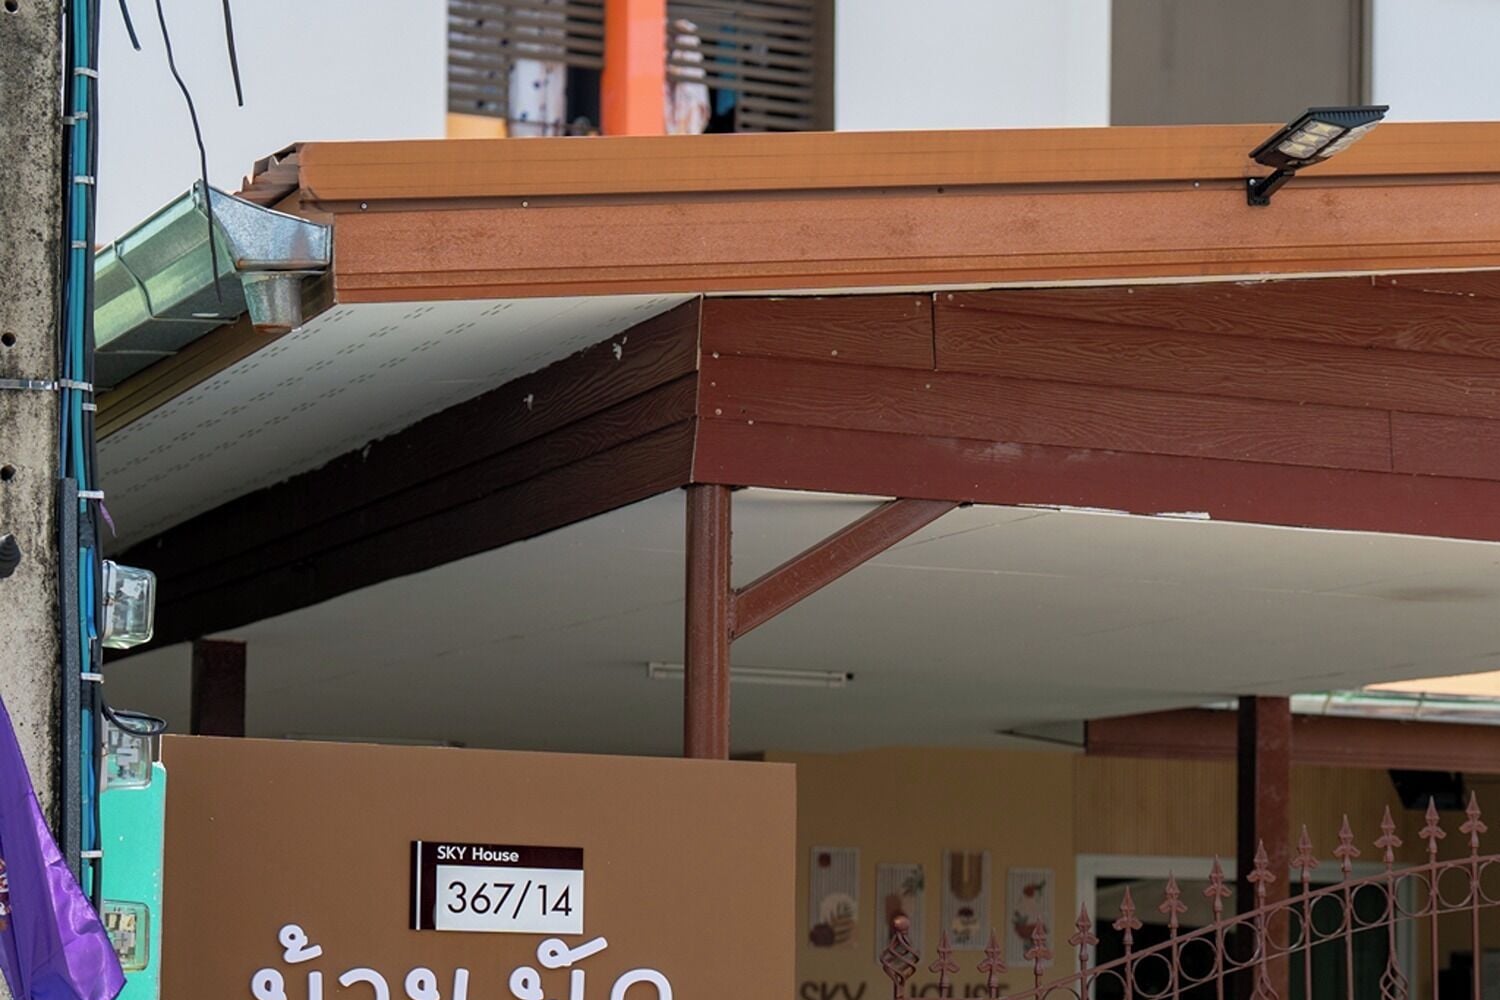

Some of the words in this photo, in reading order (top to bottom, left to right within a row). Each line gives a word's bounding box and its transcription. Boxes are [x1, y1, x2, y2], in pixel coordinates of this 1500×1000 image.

[436, 845, 467, 860] SKY
[472, 847, 520, 862] House
[447, 879, 573, 920] 367/14
